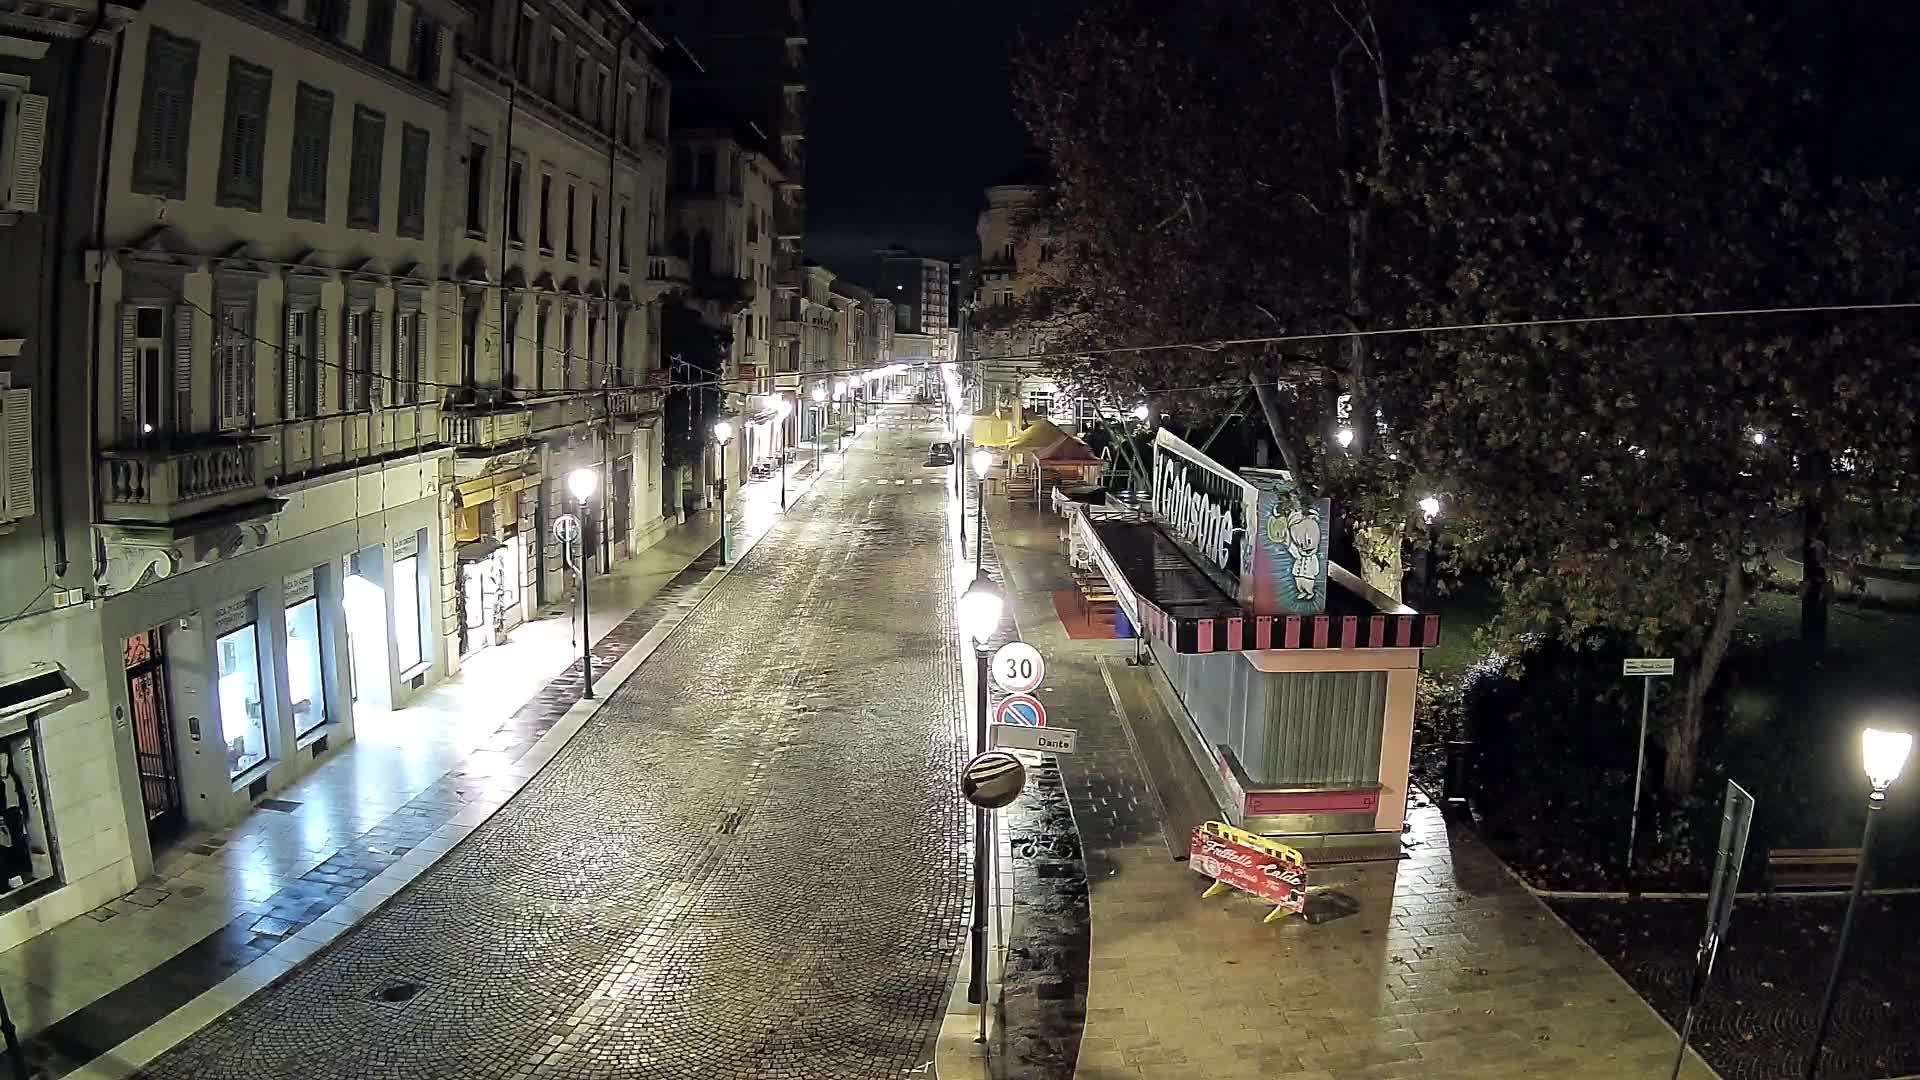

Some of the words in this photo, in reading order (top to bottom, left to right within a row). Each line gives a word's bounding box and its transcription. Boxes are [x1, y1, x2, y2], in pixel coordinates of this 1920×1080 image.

[1162, 459, 1232, 569] Golosone
[1006, 659, 1032, 679] 30
[1038, 737, 1070, 749] Dante
